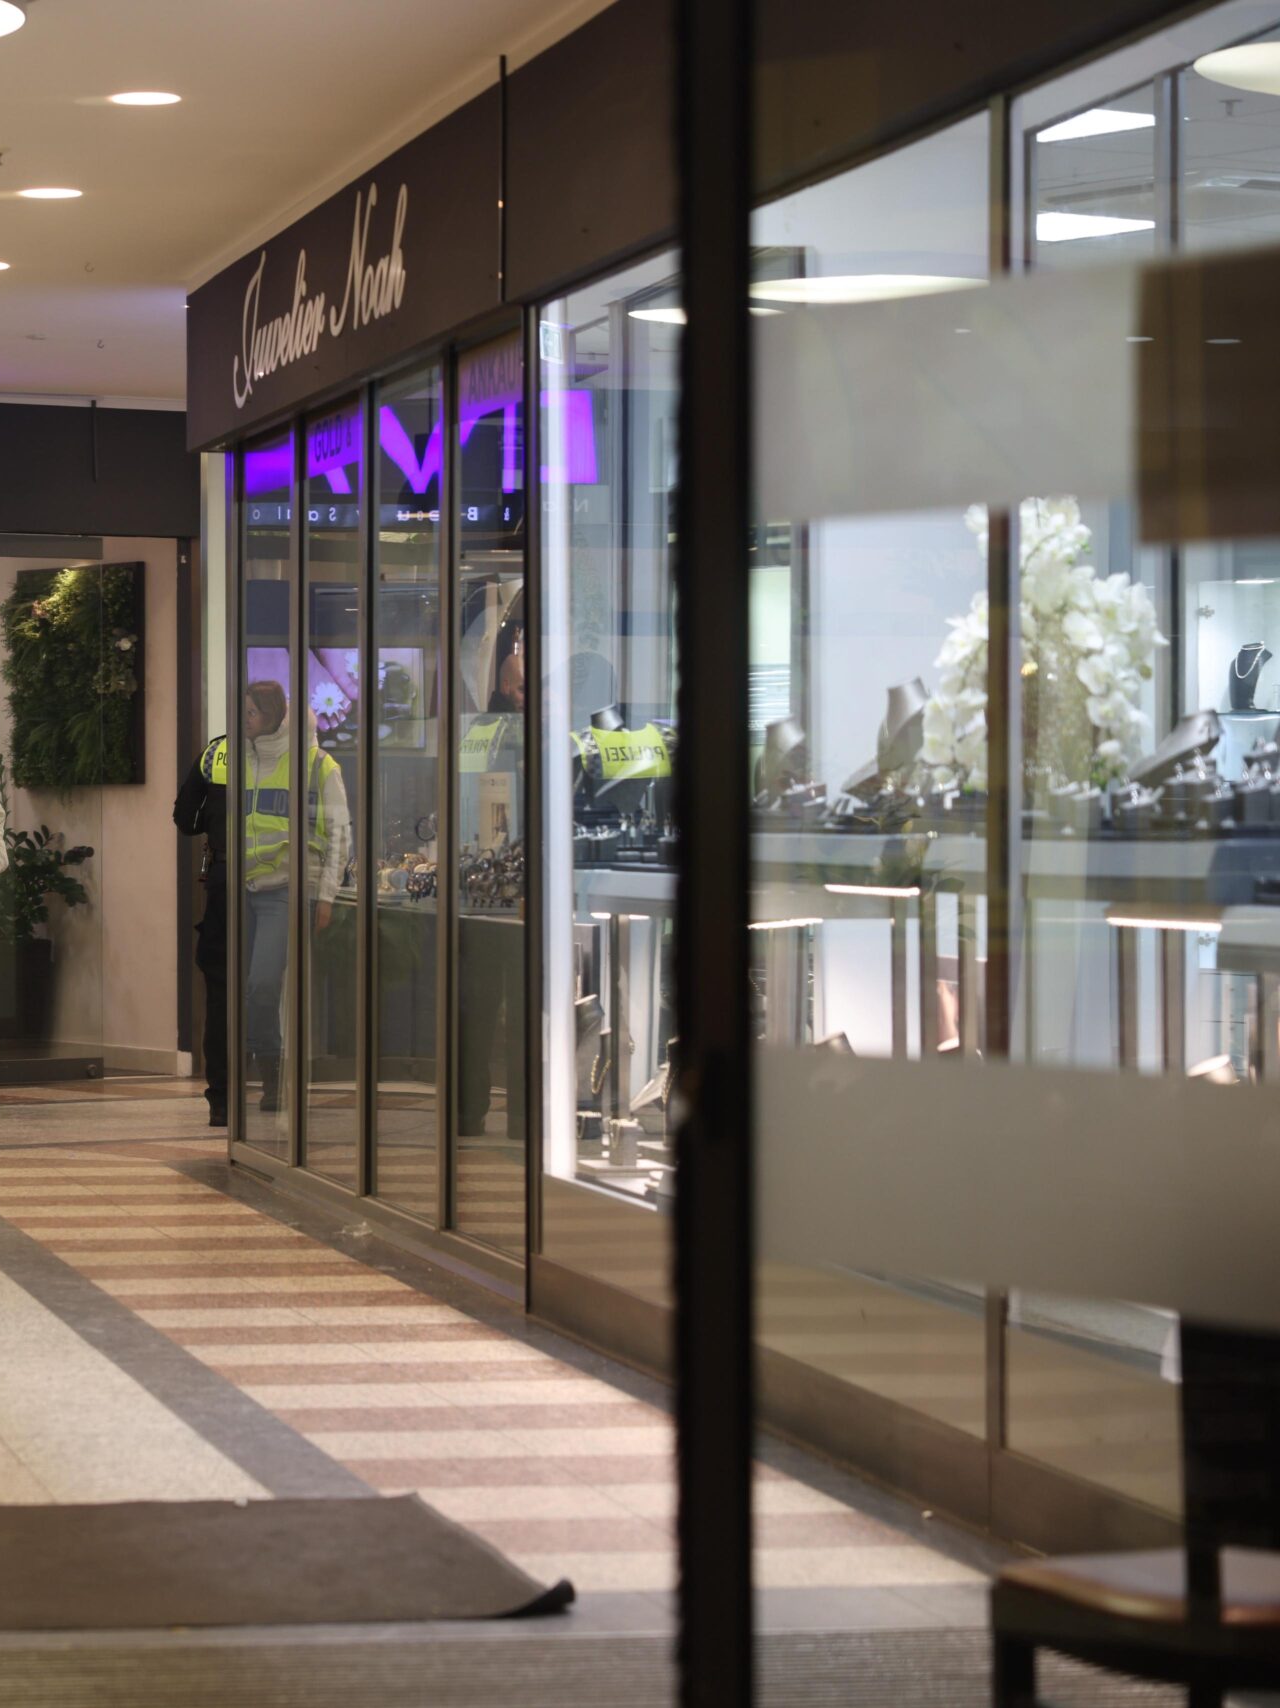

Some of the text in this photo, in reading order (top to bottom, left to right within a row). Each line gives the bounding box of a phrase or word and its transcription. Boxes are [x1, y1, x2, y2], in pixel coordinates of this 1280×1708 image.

[232, 182, 409, 409] Juwelier Noah
[314, 414, 342, 463] GOLD
